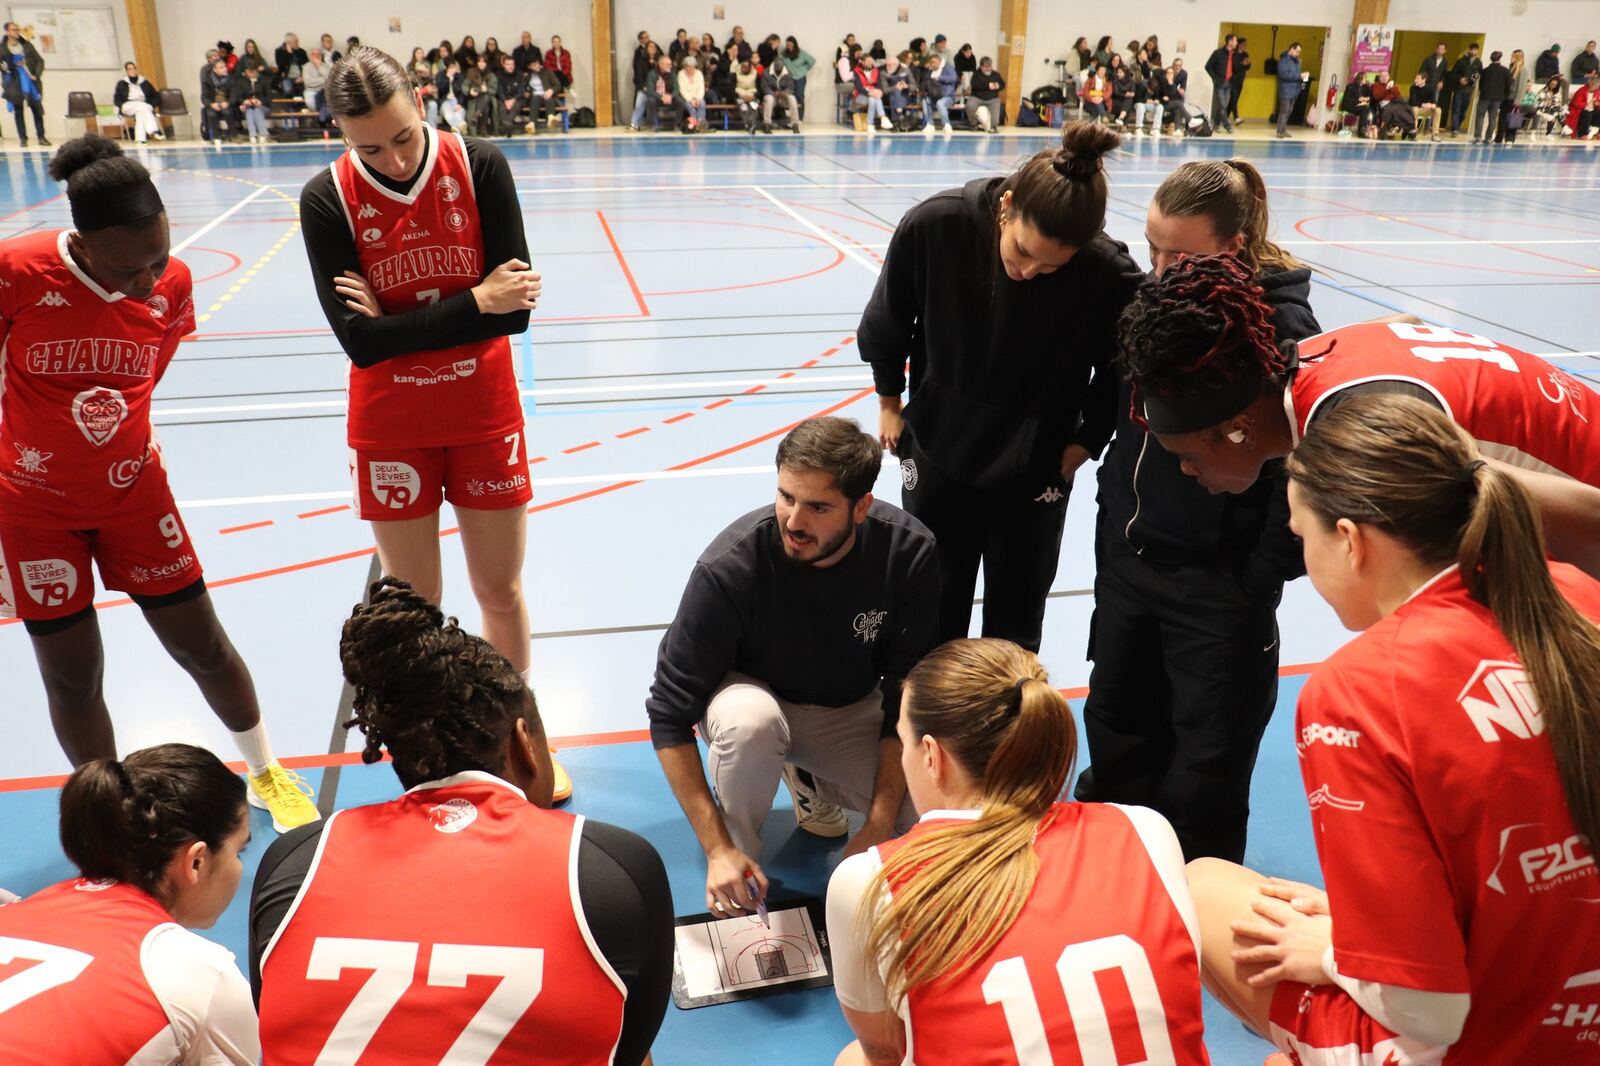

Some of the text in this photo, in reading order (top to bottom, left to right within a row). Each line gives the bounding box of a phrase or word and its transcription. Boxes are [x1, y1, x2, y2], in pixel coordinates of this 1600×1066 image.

[402, 229, 431, 241] AKENA
[368, 246, 480, 293] CHAURAY
[393, 363, 475, 387] kangourou kids
[504, 432, 520, 466] 7
[375, 465, 399, 473] DEUX
[377, 484, 412, 510] 79
[158, 512, 184, 549] 9
[26, 562, 54, 572] DEUX
[31, 582, 69, 608] 79
[305, 936, 545, 1066] 77
[981, 933, 1177, 1066] 10
[1576, 1029, 1600, 1046] de
